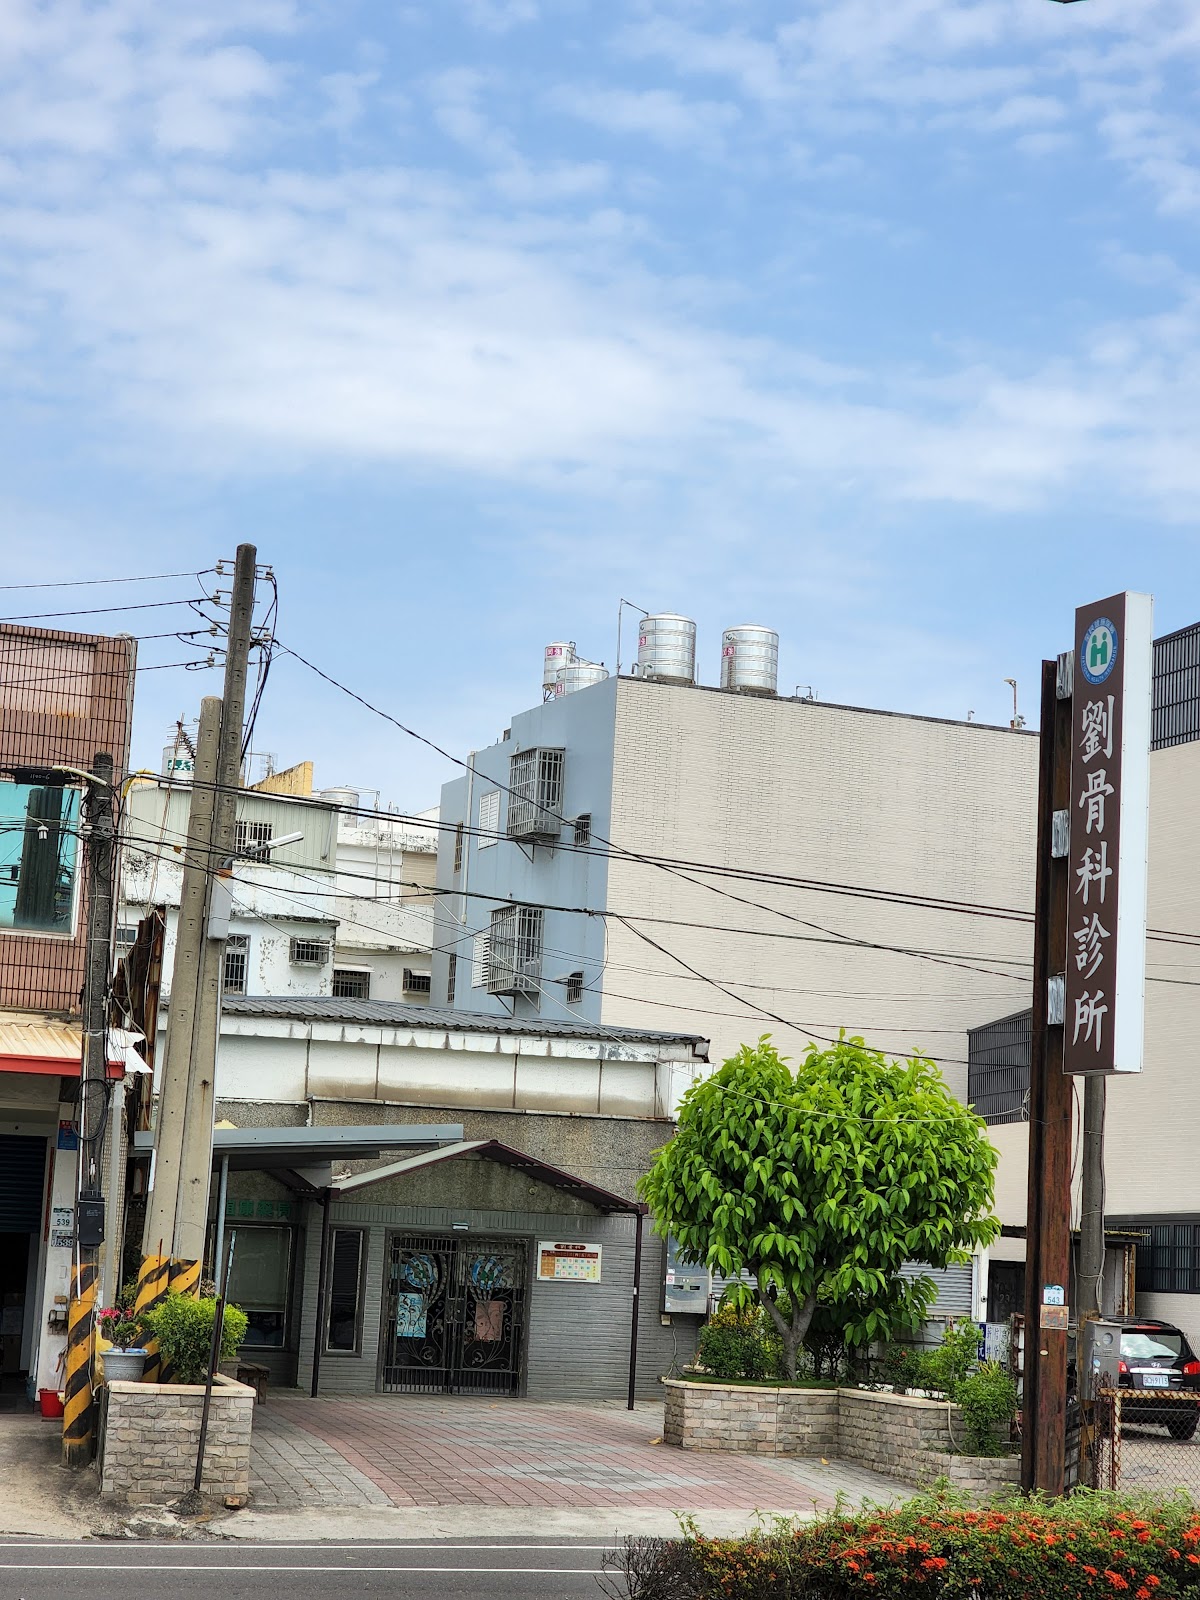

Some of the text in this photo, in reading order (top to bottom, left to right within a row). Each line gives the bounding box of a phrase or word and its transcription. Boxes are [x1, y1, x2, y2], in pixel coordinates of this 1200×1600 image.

[1072, 694, 1115, 1053] 劉骨科診所
[57, 1218, 70, 1226] 539
[1047, 1296, 1061, 1304] 543
